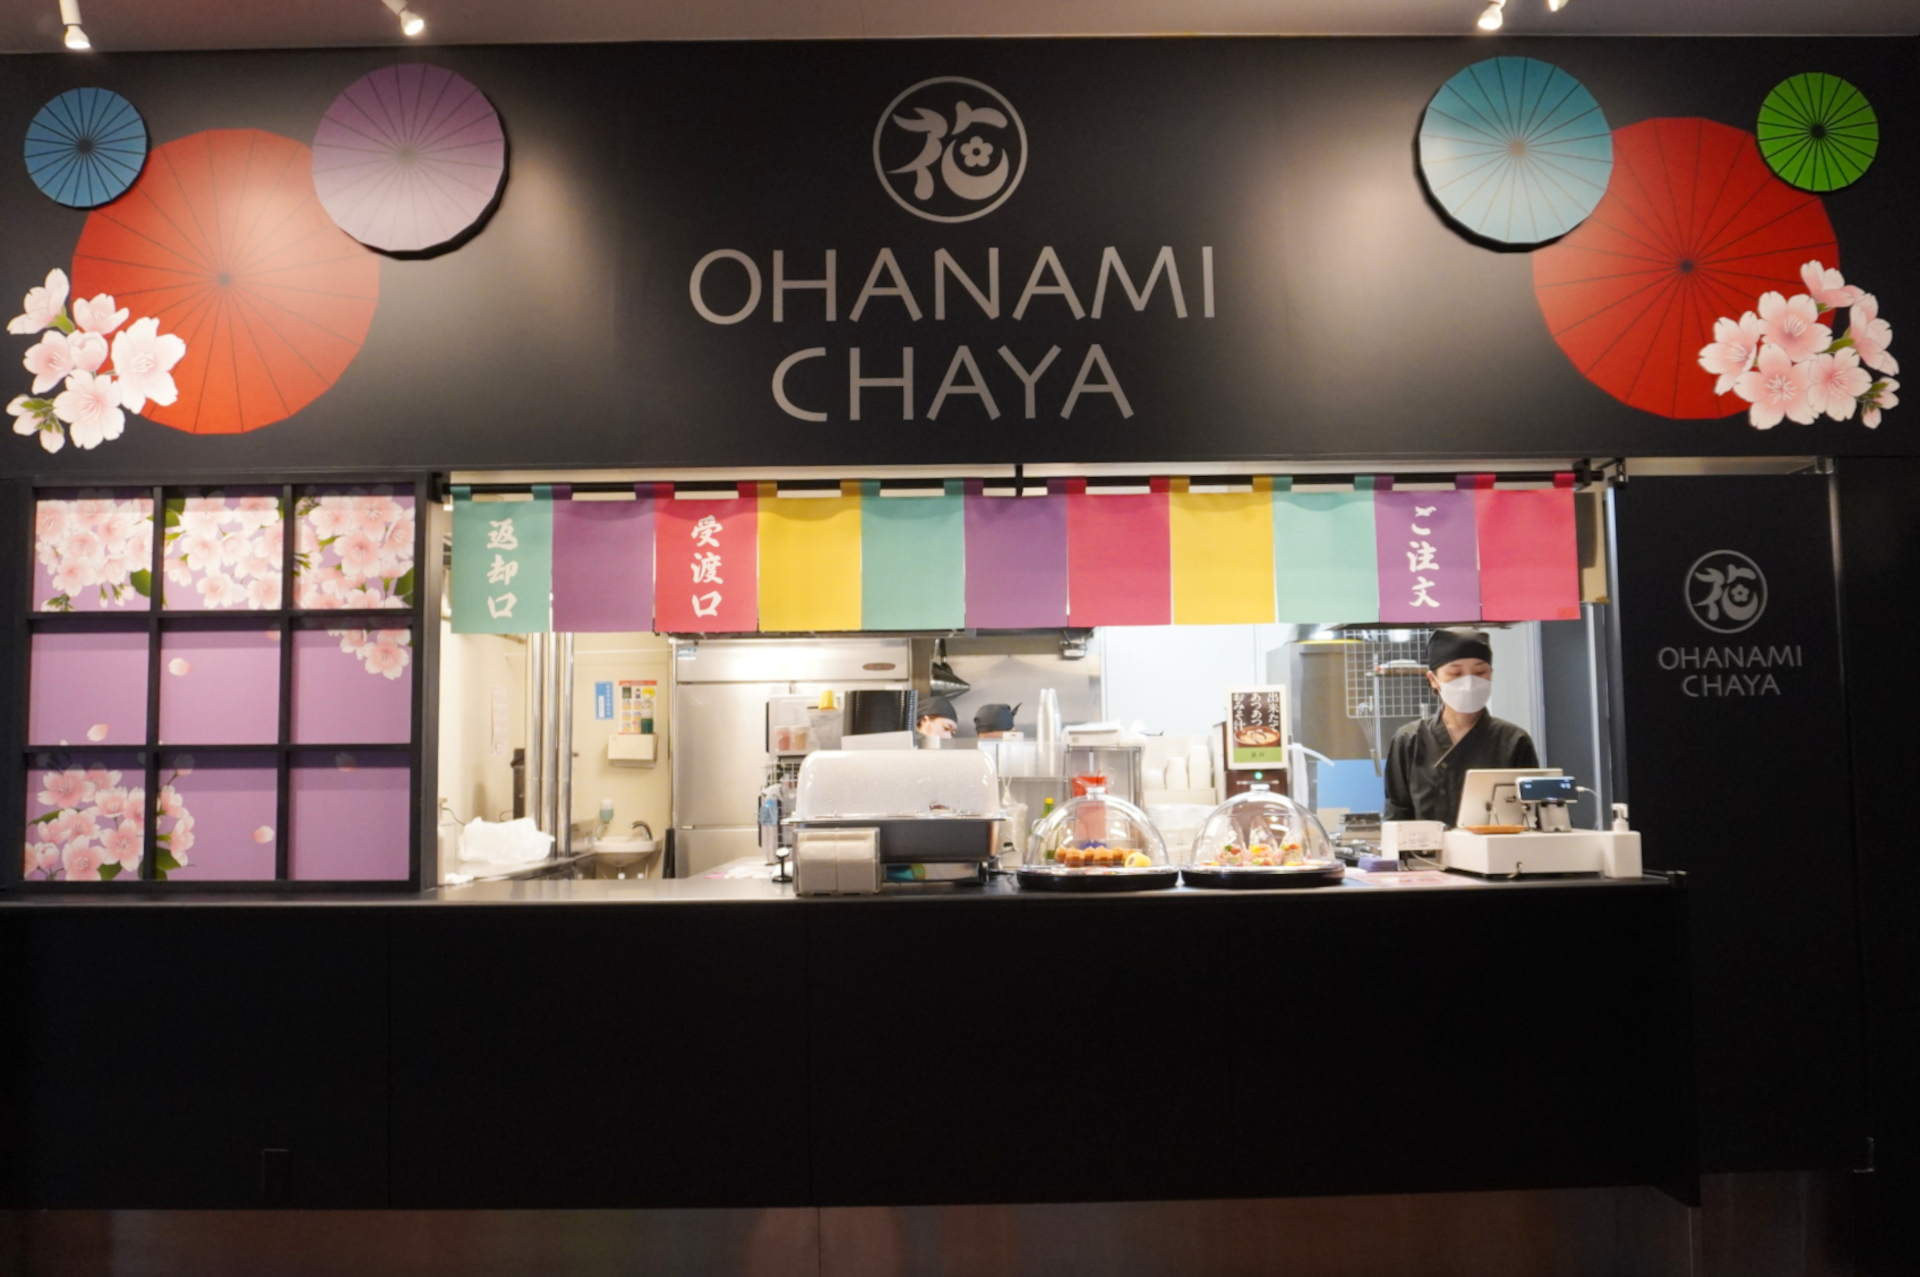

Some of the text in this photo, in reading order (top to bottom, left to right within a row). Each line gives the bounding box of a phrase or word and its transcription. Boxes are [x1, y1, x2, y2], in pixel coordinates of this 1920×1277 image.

[689, 245, 1216, 325] OHANAMI
[771, 343, 1135, 423] CHAYA
[486, 517, 519, 620] 返却口
[690, 514, 724, 618] 受渡口
[1406, 505, 1441, 609] ご注文
[1658, 645, 1803, 671] OHANAMI
[1681, 673, 1781, 698] CHAYA
